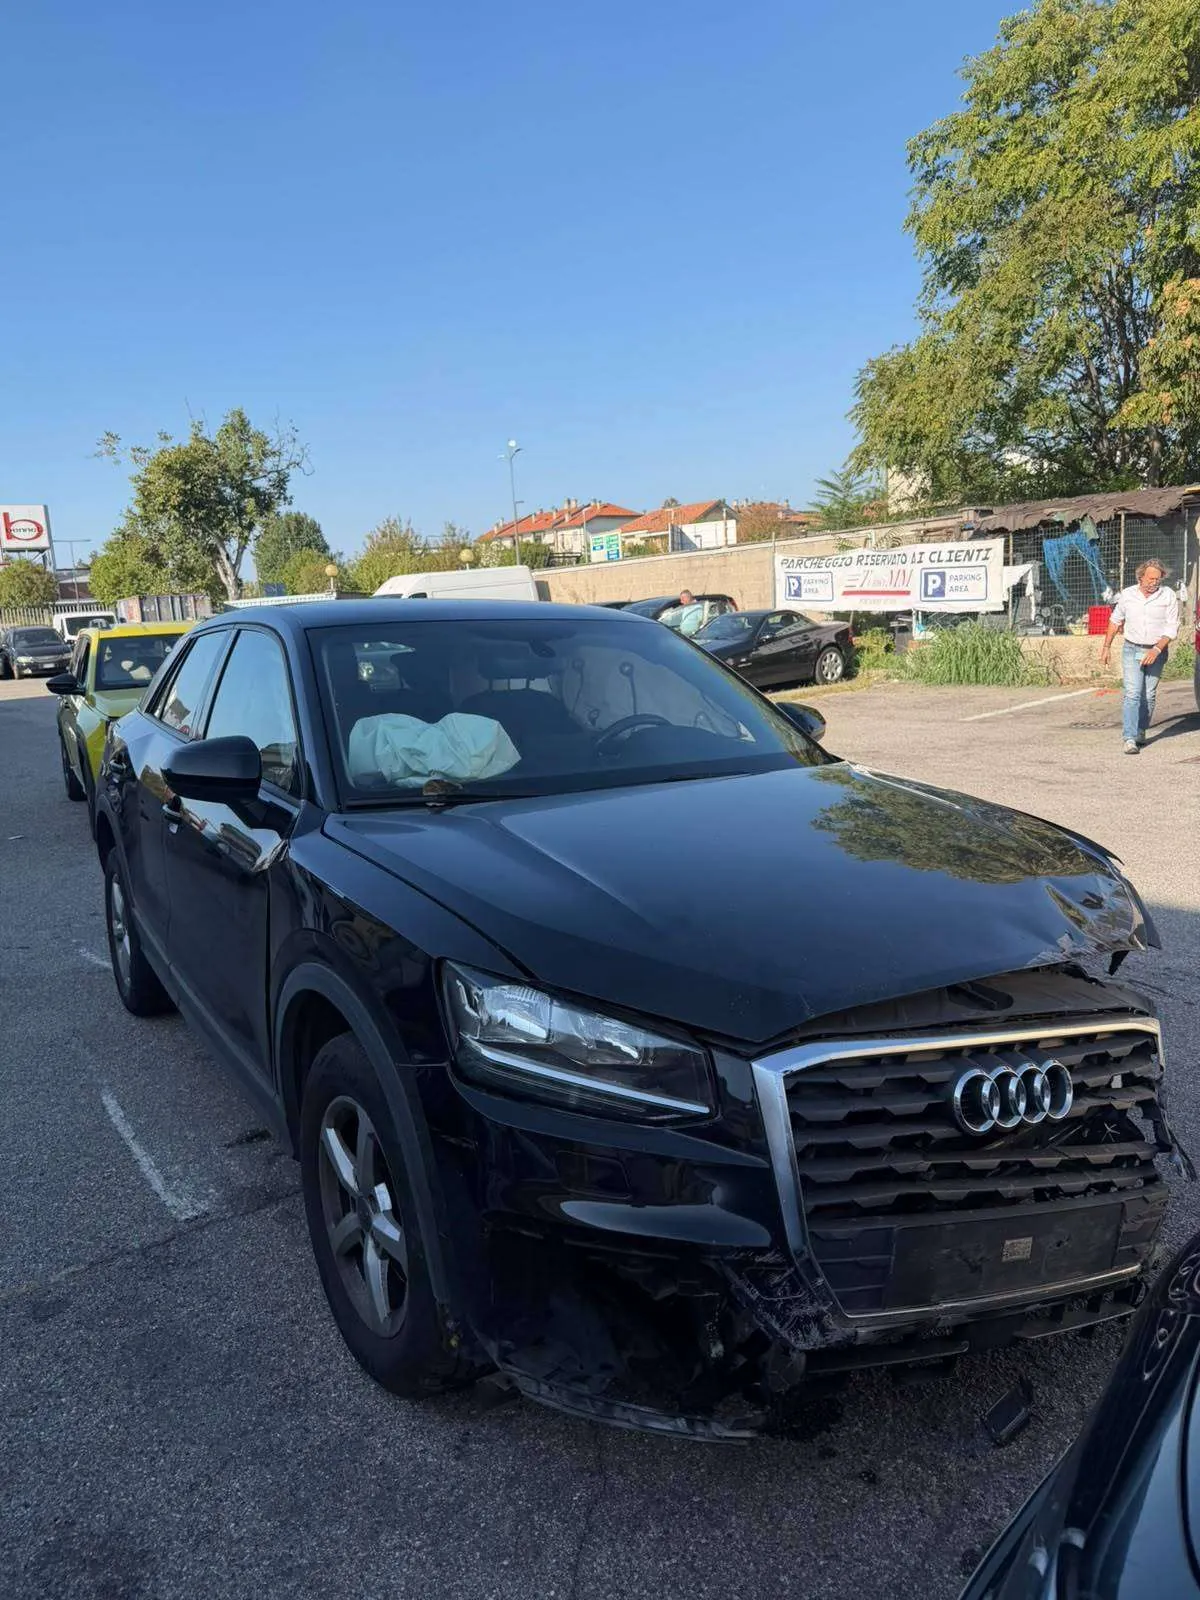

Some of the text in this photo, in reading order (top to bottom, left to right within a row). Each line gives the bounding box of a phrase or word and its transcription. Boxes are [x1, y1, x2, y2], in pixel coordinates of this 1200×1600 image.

[780, 556, 853, 569] PARCHEGGIO
[856, 552, 907, 566] RISERVATO
[928, 548, 992, 563] CLIENTI
[788, 576, 800, 595] P
[927, 574, 941, 596] P
[949, 574, 982, 582] PARKING
[948, 585, 969, 593] AREA
